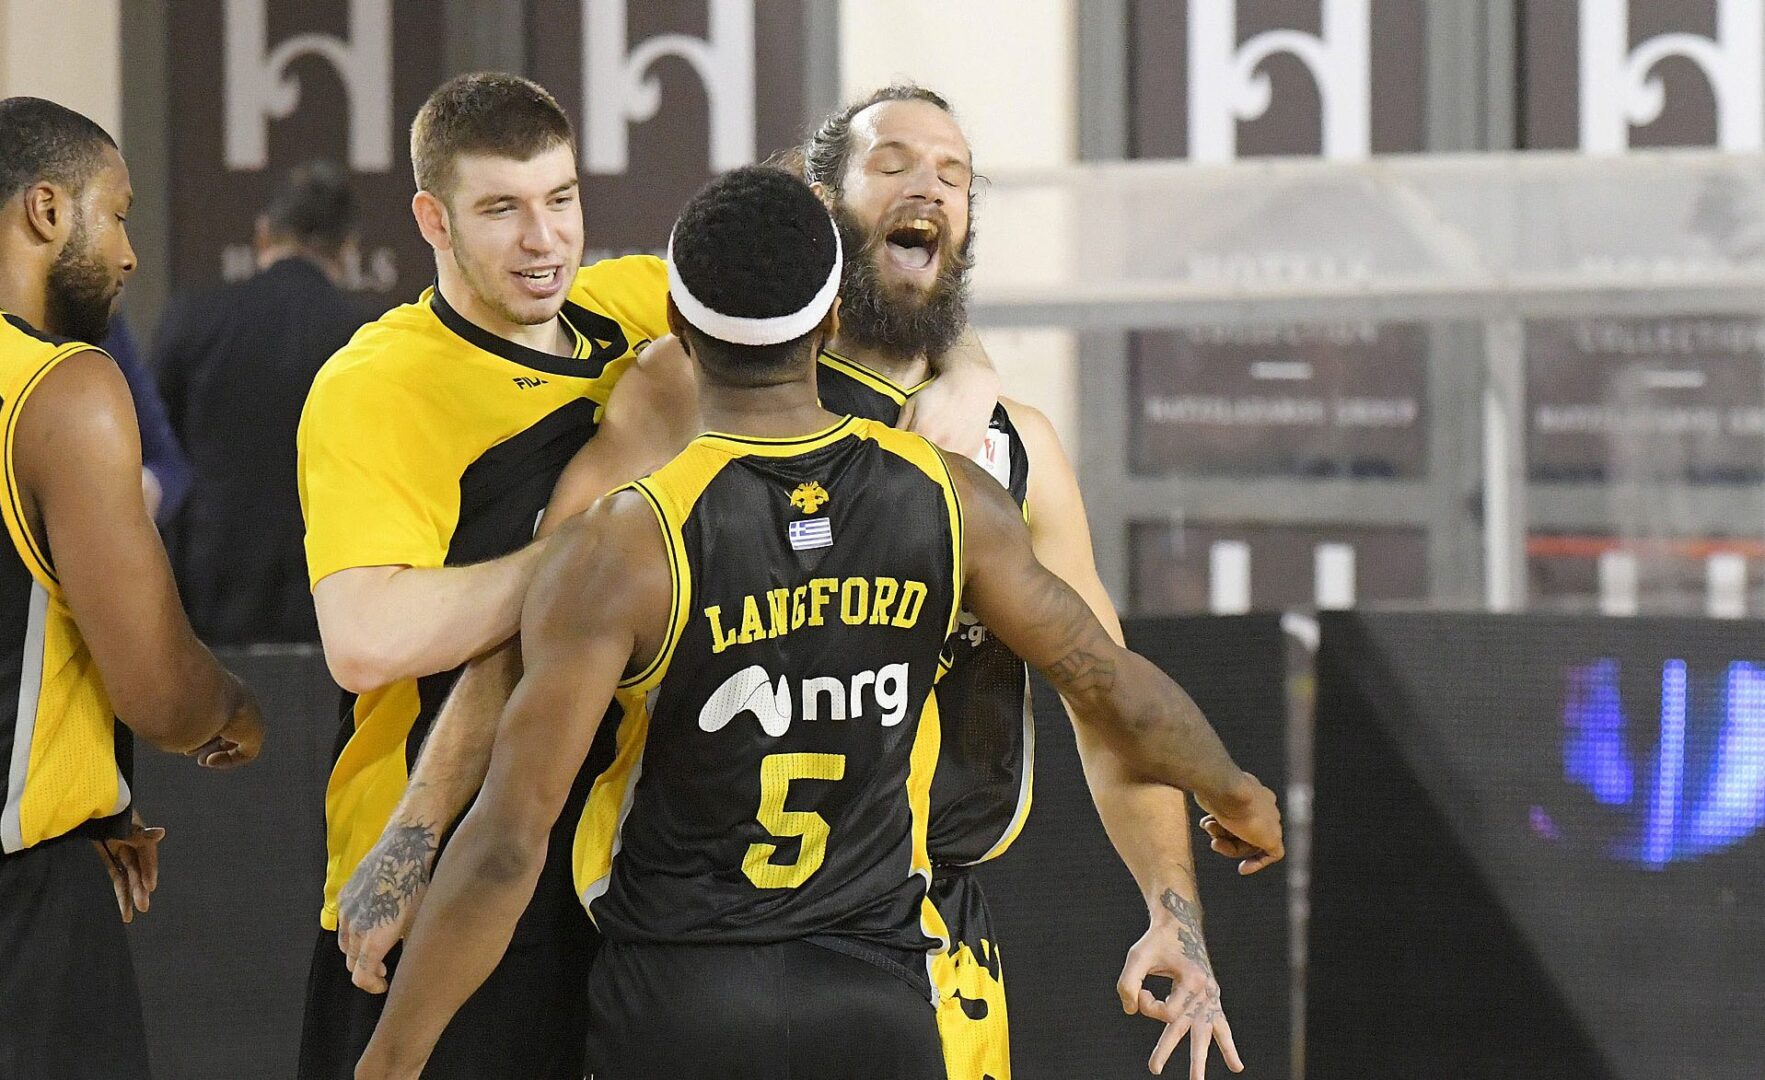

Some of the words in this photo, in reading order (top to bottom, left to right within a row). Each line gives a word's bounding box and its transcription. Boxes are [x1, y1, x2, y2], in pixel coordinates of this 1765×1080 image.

[704, 576, 928, 654] LANGFORD
[802, 662, 909, 727] nrg
[741, 752, 847, 889] 5
